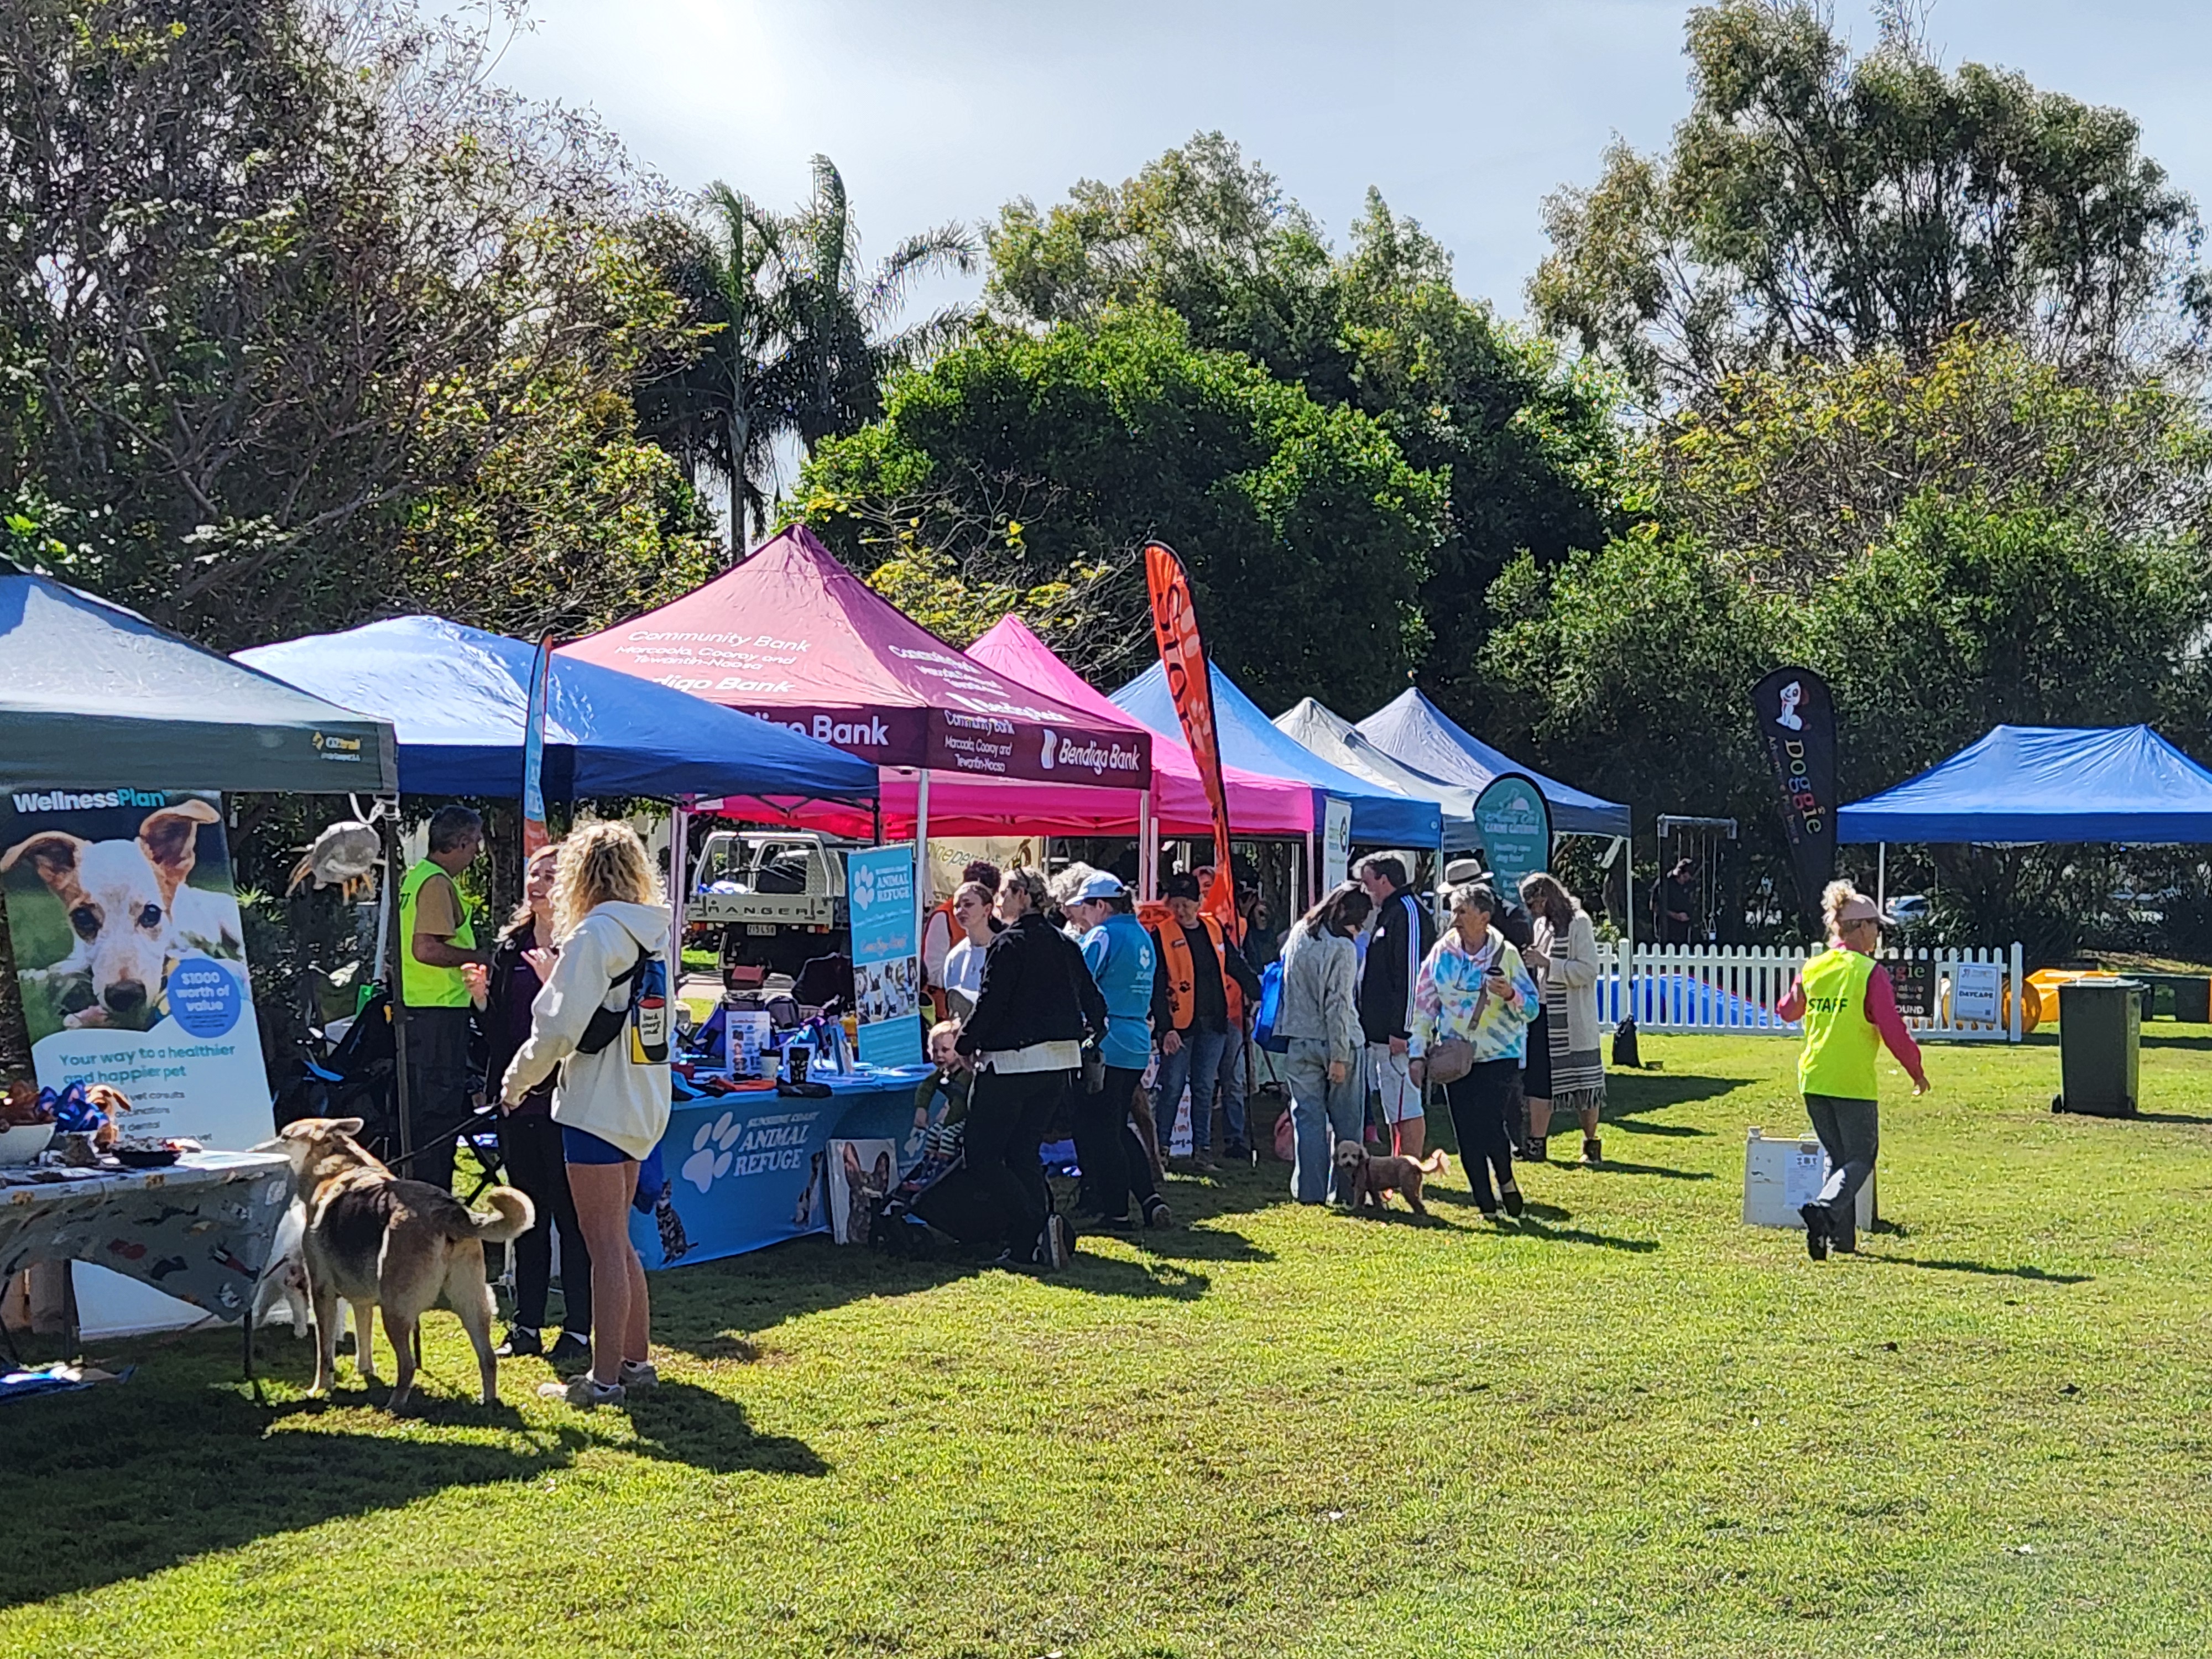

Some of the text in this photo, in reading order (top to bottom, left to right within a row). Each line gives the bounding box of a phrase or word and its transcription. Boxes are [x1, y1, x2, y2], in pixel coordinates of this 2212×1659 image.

[628, 631, 811, 652] Community Bank
[761, 656, 797, 664] and
[714, 677, 796, 692] Bank
[813, 714, 889, 745] Bank
[1058, 738, 1141, 775] Bendigo Bank
[1785, 739, 1827, 834] Doggie
[877, 873, 909, 888] ANIMAL
[877, 886, 910, 902] REFUGE
[181, 972, 220, 985] $1000
[175, 984, 229, 998] worth of
[186, 1000, 223, 1011] value
[1808, 997, 1848, 1013] STAFF
[59, 1043, 236, 1066] Your way to a healthier
[97, 1065, 160, 1086] happier
[163, 1065, 187, 1081] pet
[738, 1125, 810, 1152] ANIMAL
[733, 1149, 804, 1177] REFUGE
